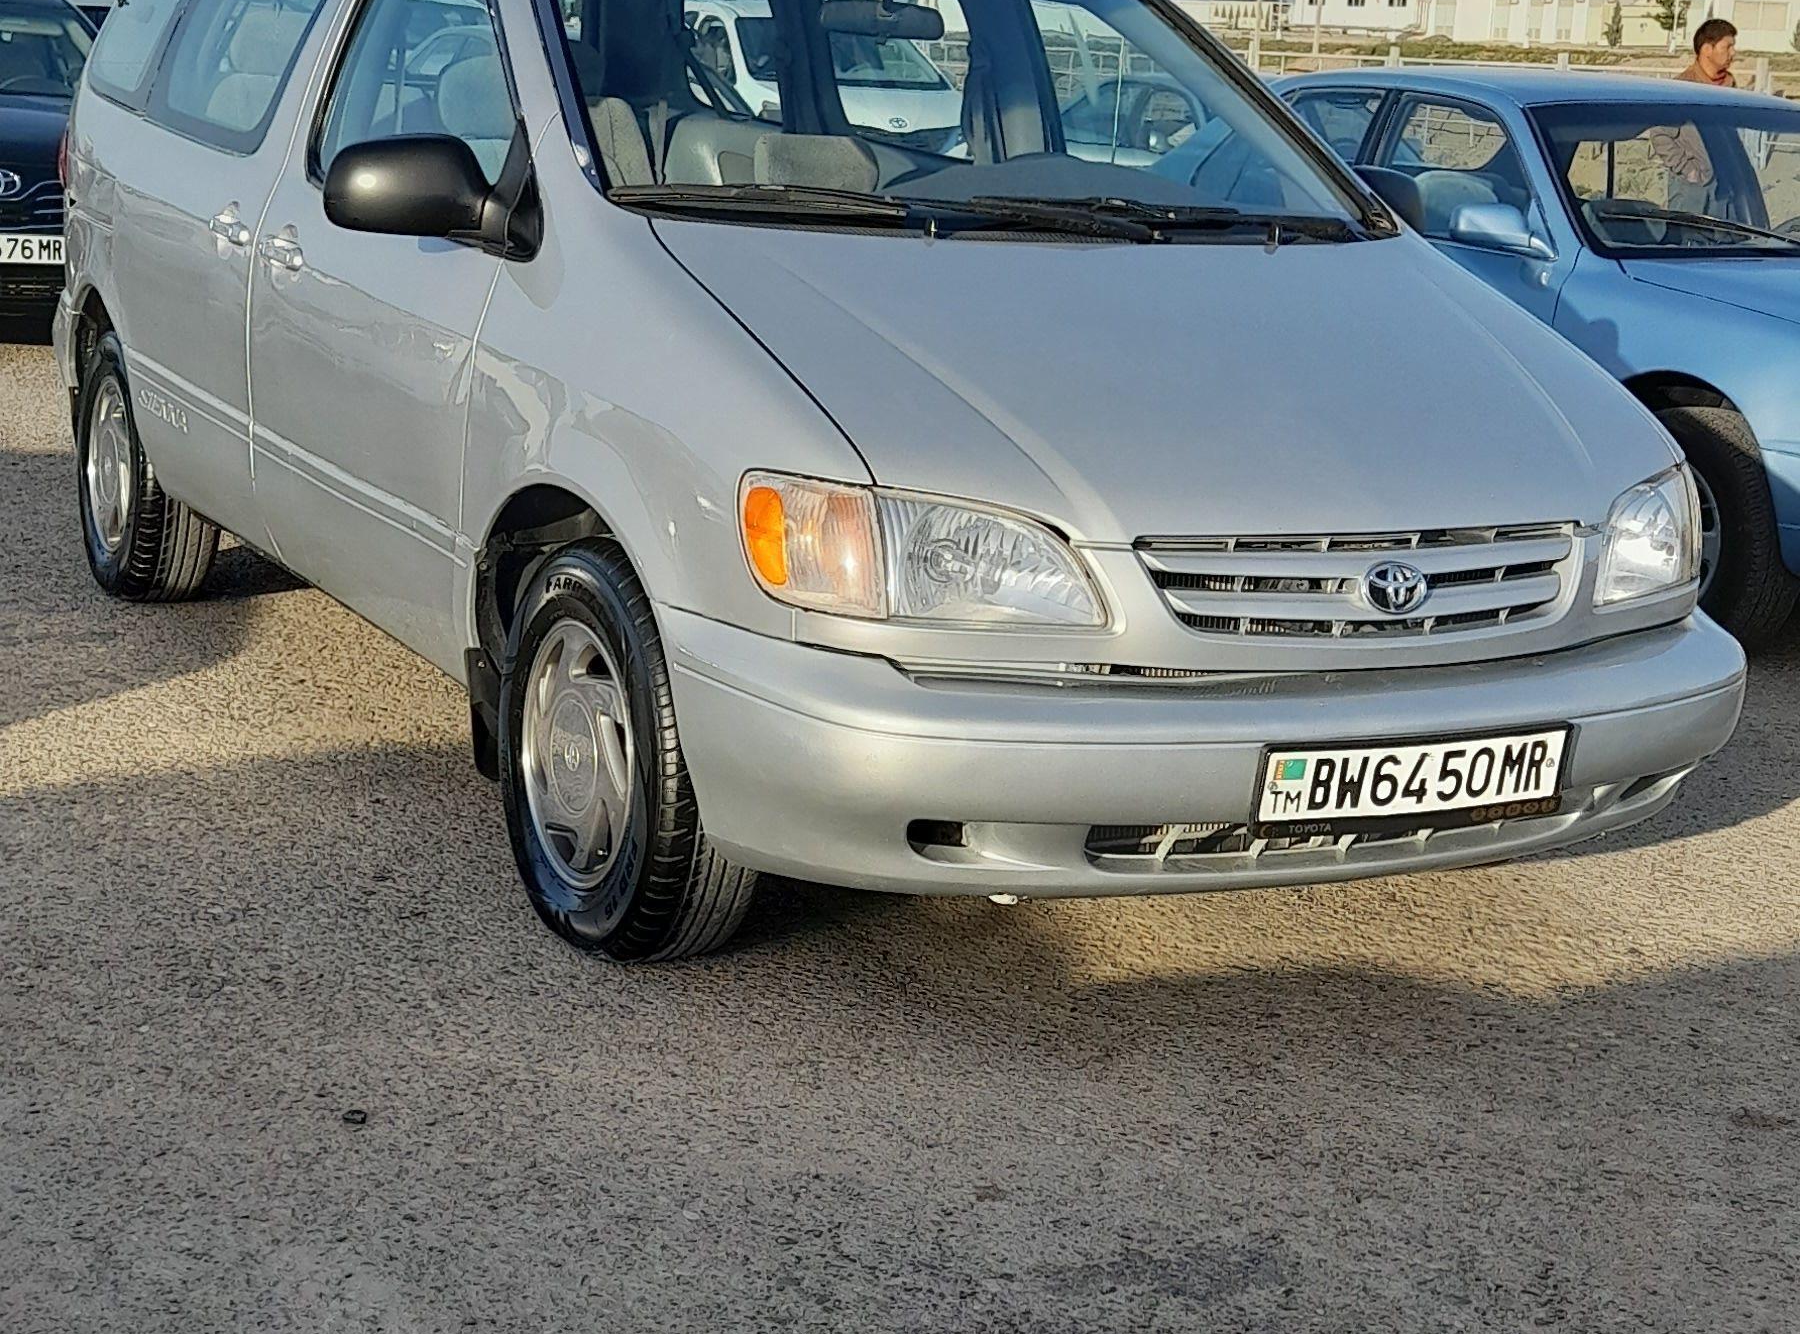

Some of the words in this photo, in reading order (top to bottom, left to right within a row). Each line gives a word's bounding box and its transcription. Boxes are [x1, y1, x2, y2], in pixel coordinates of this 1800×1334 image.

[0, 237, 62, 261] 76MR
[1307, 740, 1548, 811] BW6450MR
[1269, 790, 1302, 814] TM
[1288, 823, 1333, 834] TOYOTA
